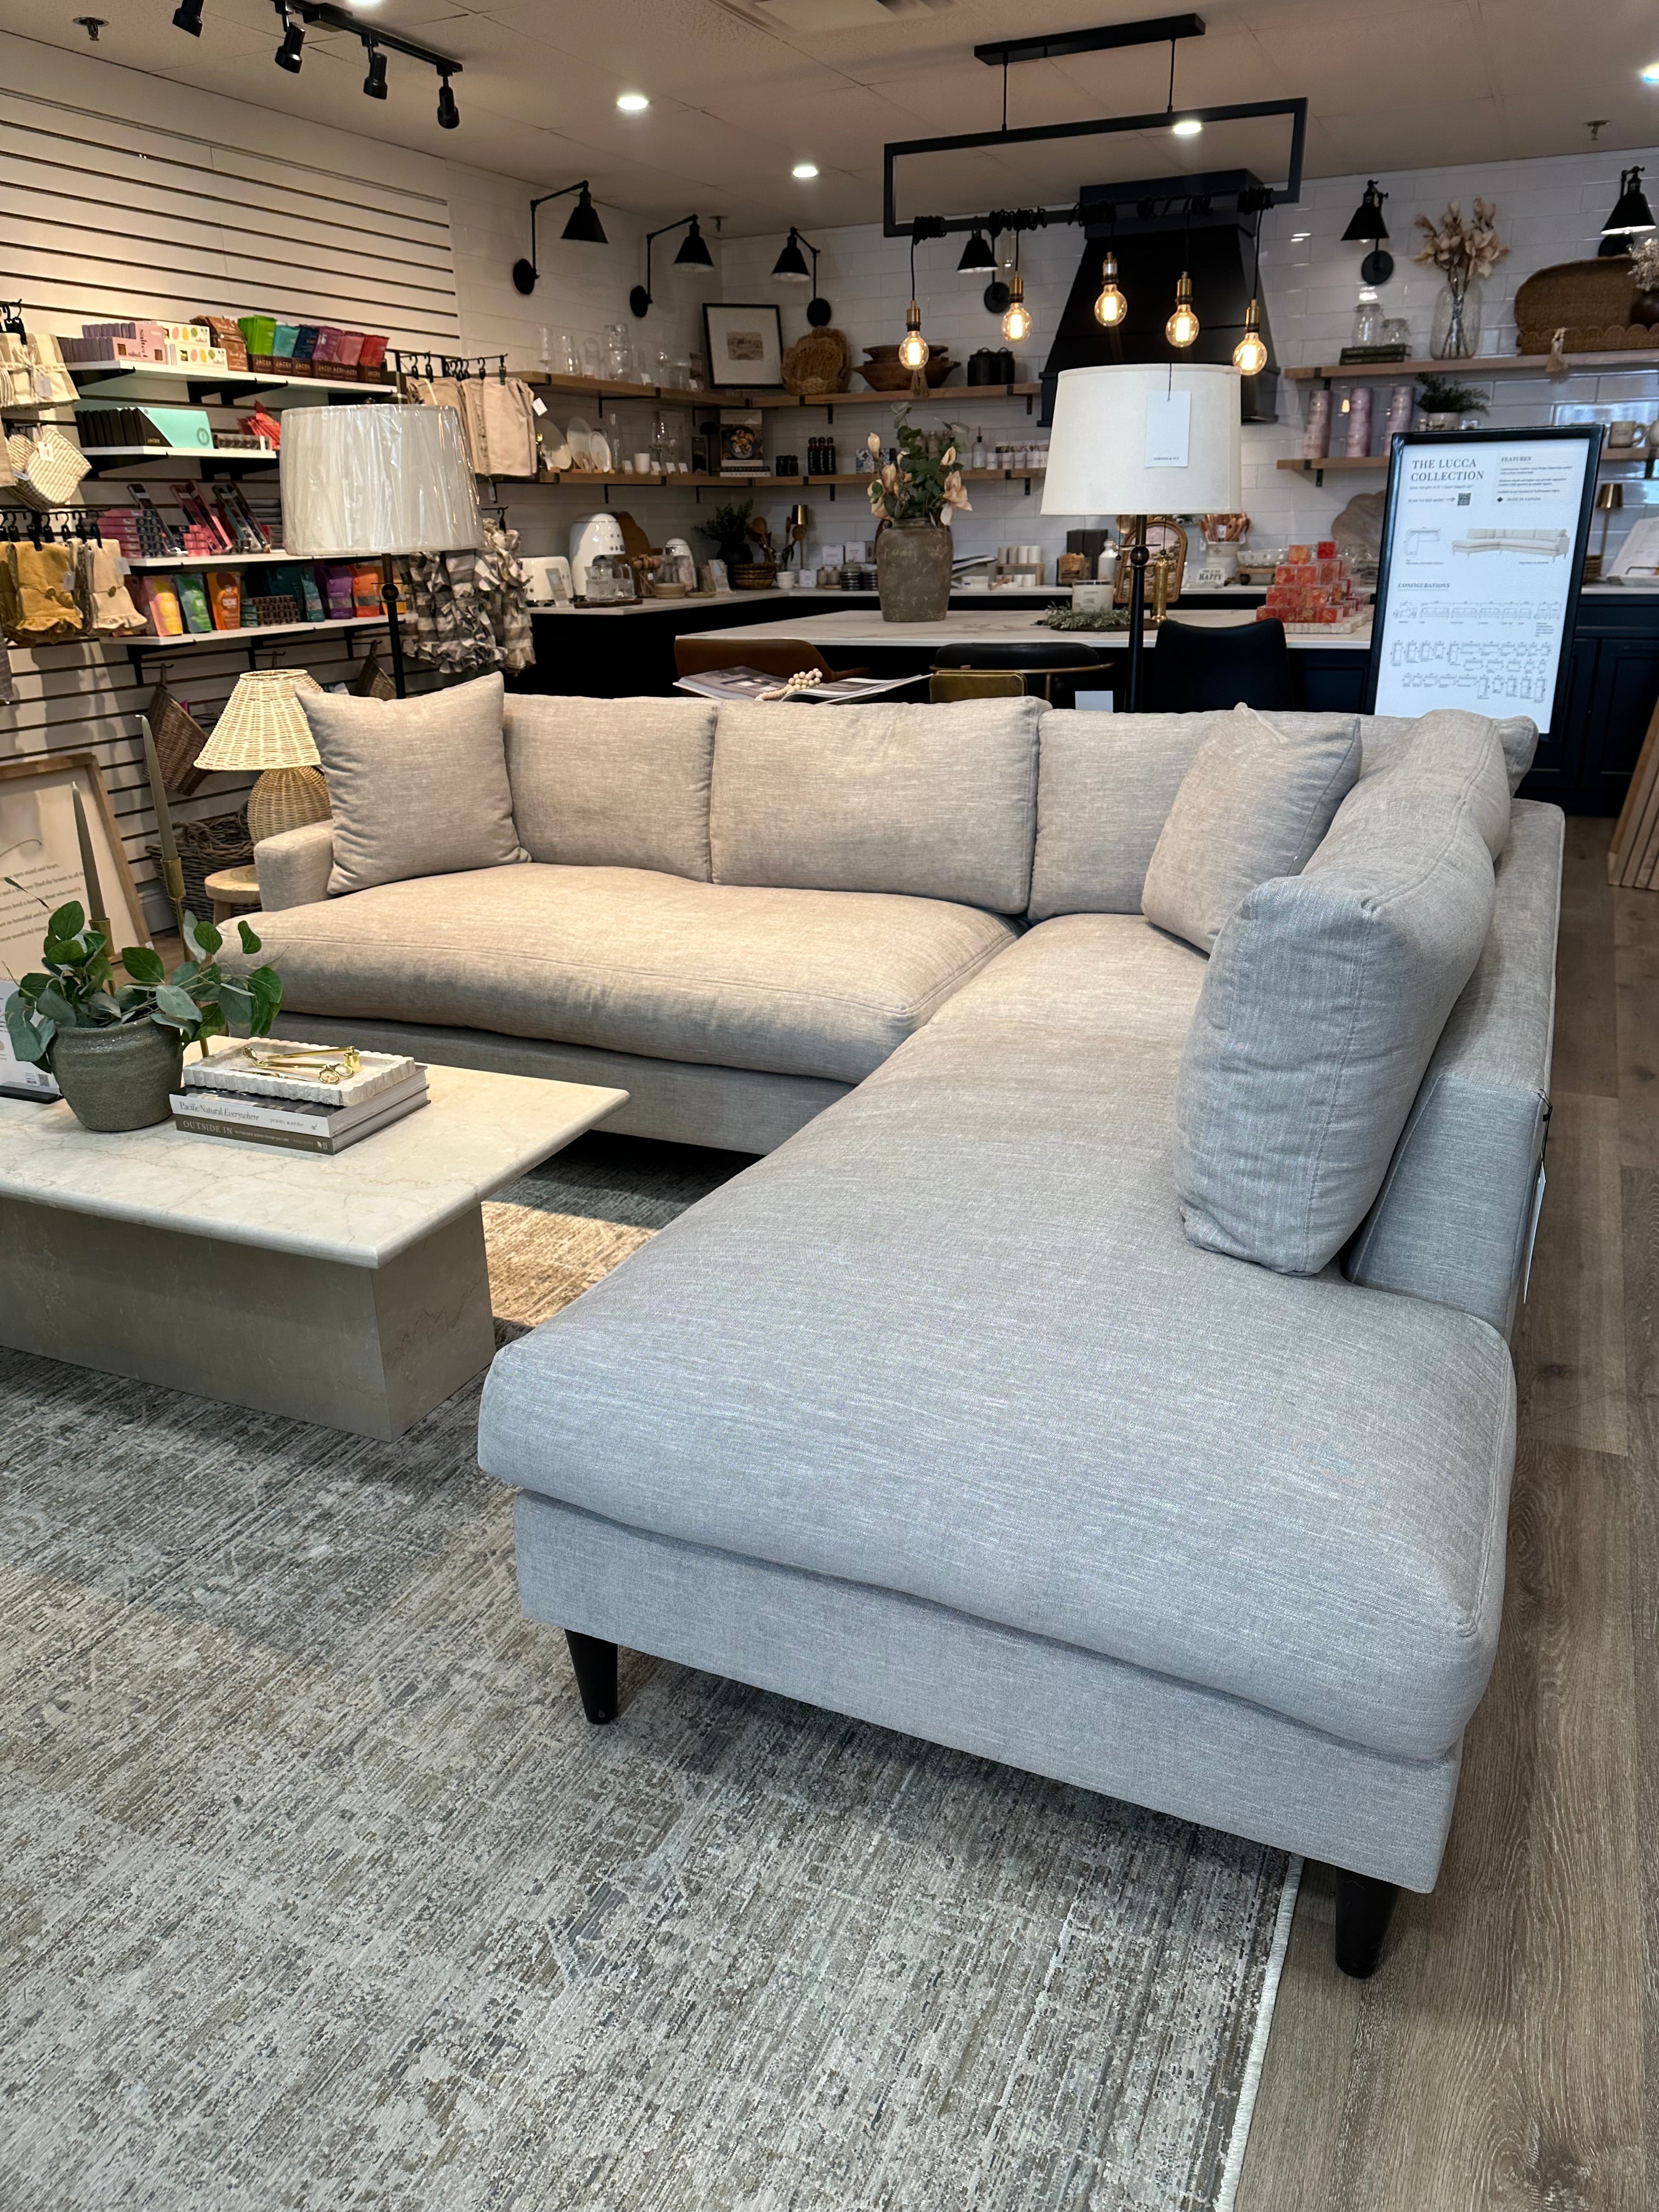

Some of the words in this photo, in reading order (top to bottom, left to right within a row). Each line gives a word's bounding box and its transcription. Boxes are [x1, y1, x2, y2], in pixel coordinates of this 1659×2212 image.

[1412, 459, 1435, 469] THE
[1438, 458, 1477, 469] LUCCA
[1410, 470, 1484, 482] COLLECTION
[179, 1101, 200, 1113] Pacific
[200, 1104, 223, 1116] Natural
[224, 1108, 259, 1121] Everywhere
[183, 1120, 221, 1133] OUTSIDE
[223, 1126, 233, 1135] IN
